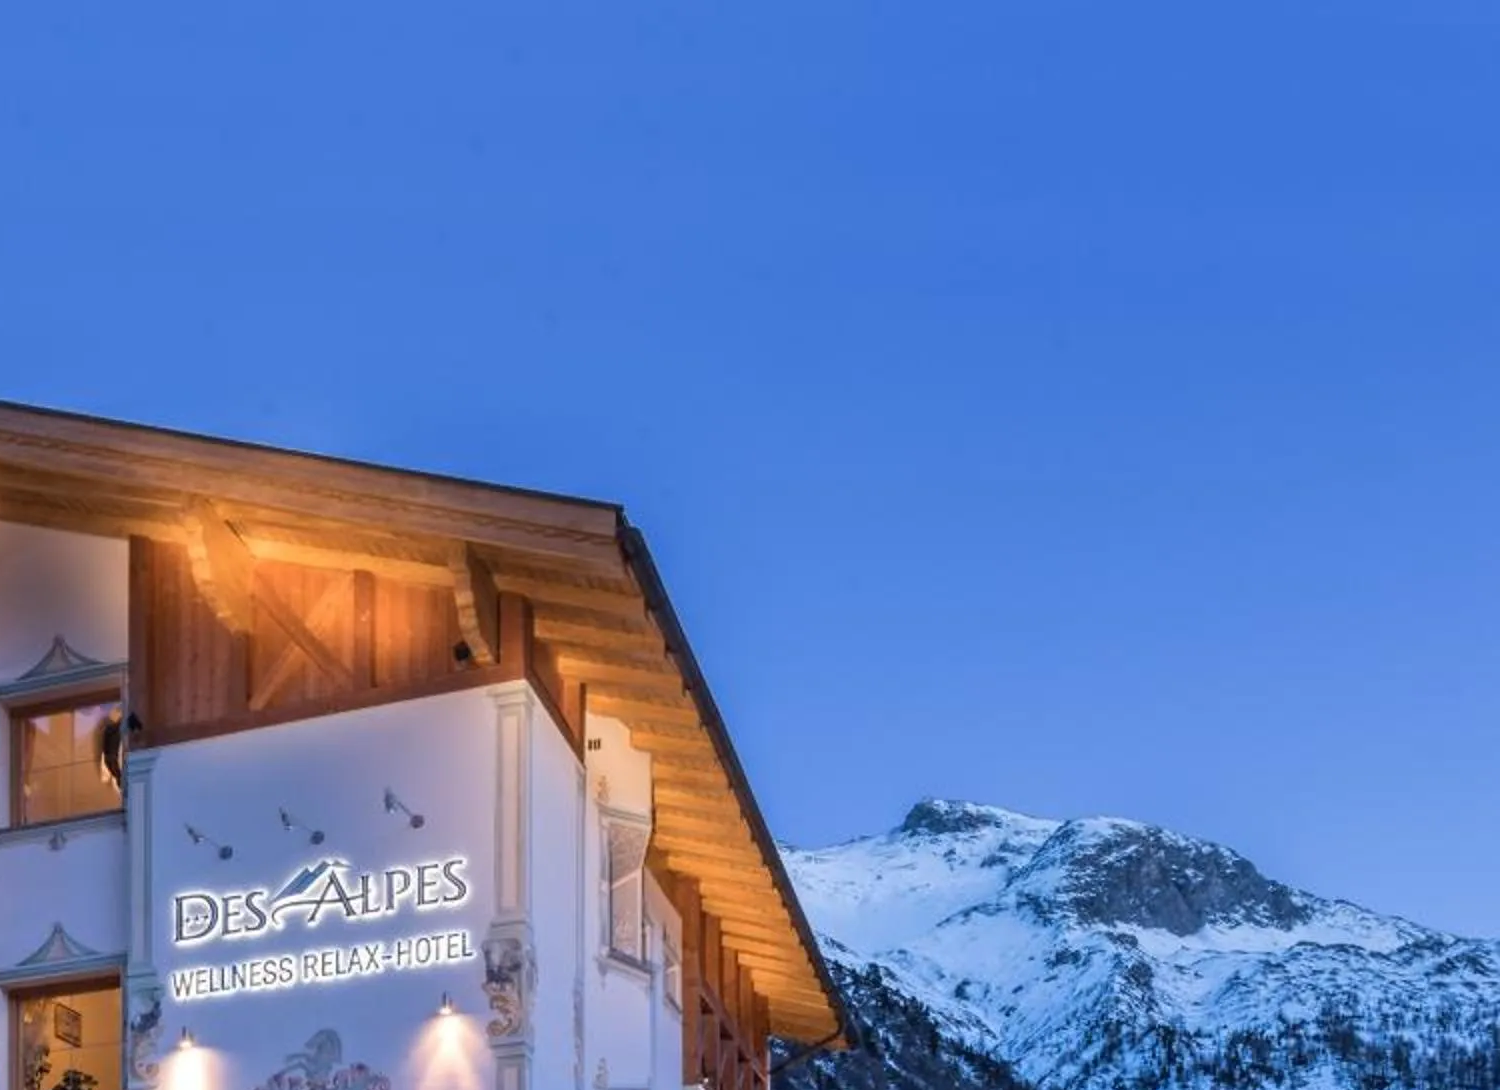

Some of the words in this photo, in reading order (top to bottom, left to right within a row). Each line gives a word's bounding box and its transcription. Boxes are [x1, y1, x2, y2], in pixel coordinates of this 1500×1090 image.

[174, 890, 267, 942] DES
[271, 859, 468, 923] ALPES
[172, 956, 294, 998] WELLNESS
[302, 931, 474, 979] RELAX-HOTEL
